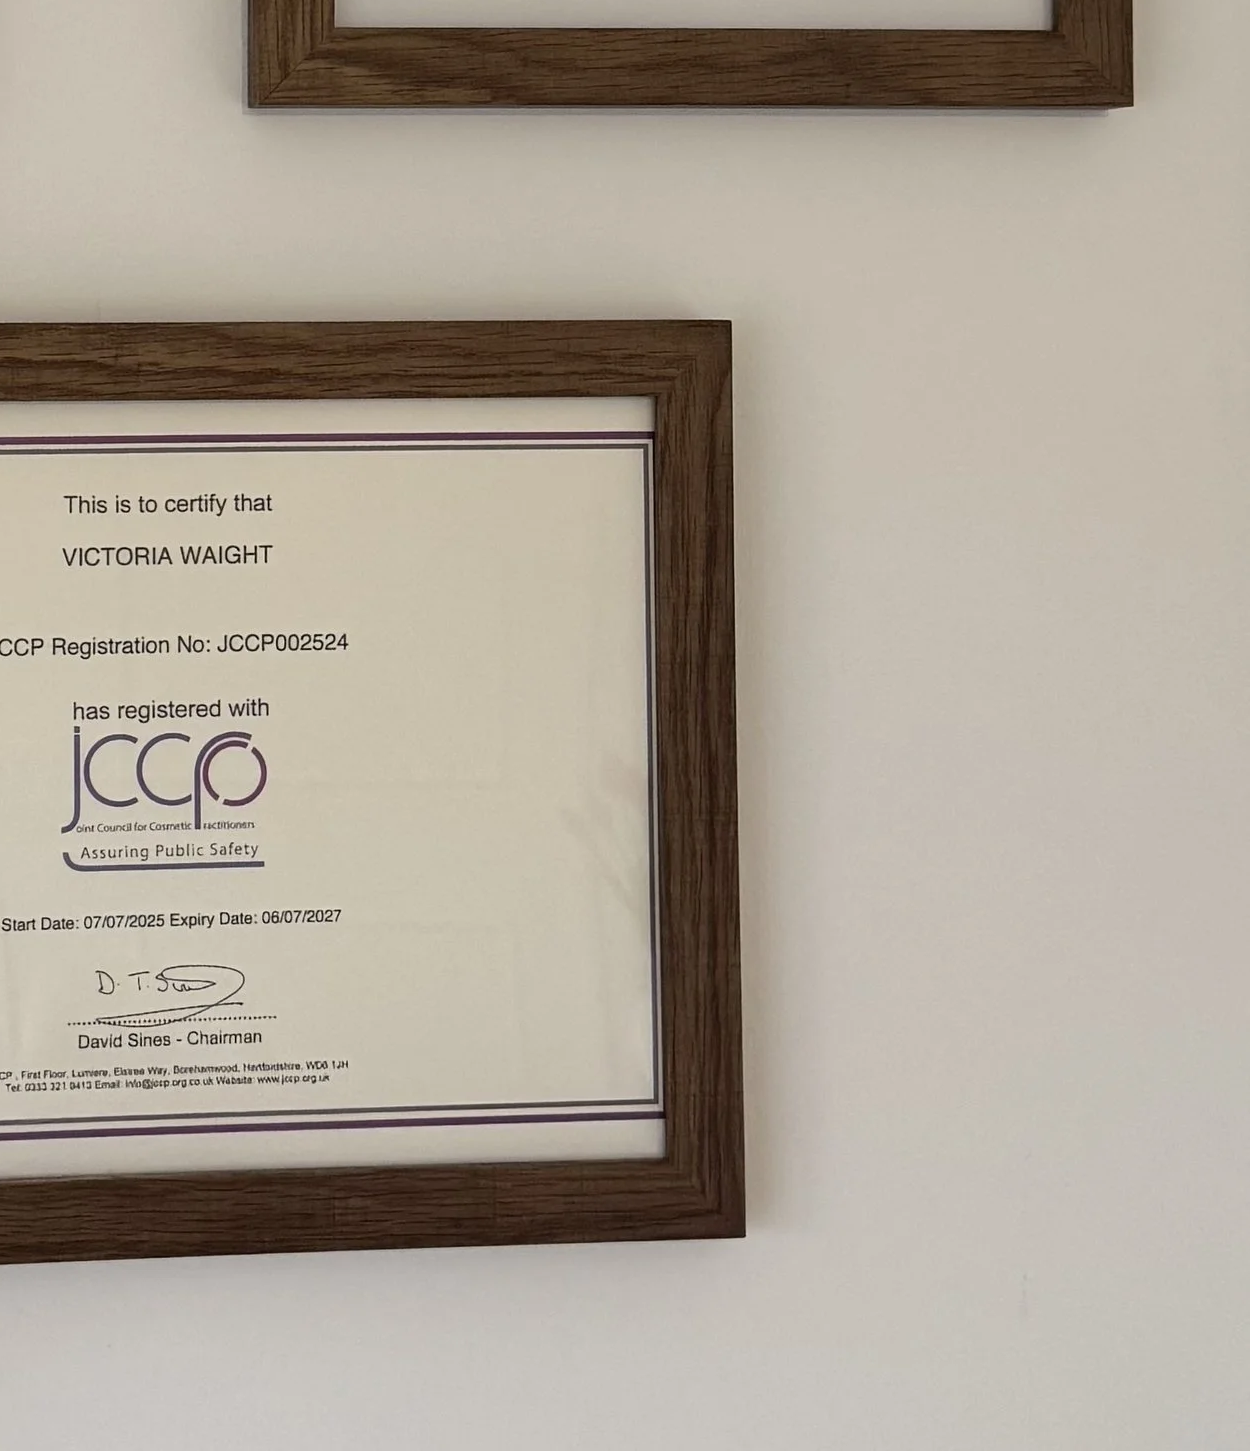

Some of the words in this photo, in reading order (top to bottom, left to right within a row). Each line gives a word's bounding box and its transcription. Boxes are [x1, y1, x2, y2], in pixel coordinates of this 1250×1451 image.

[63, 494, 108, 514] This
[115, 494, 132, 514] is
[137, 495, 158, 514] to
[164, 493, 228, 517] certify
[233, 492, 273, 512] that
[62, 546, 174, 567] VICTORIA
[179, 544, 274, 565] WAIGHT
[52, 636, 170, 660] Registration
[177, 635, 211, 654] No:
[216, 633, 349, 653] JCCP002524
[73, 701, 111, 721] has
[117, 699, 221, 724] registered
[227, 697, 270, 718] with
[133, 821, 148, 832] for
[80, 845, 149, 862] Assuring
[155, 843, 204, 858] Public
[209, 841, 259, 859] Safety
[1, 917, 37, 932] Start
[40, 916, 80, 931] Date:
[83, 913, 165, 930] 07/07/2025
[169, 912, 216, 930] Expiry
[219, 911, 258, 926] Date:
[261, 908, 342, 925] 06/07/2027
[78, 1033, 123, 1050] David
[127, 1032, 172, 1048] Sines
[186, 1029, 263, 1046] Chairman
